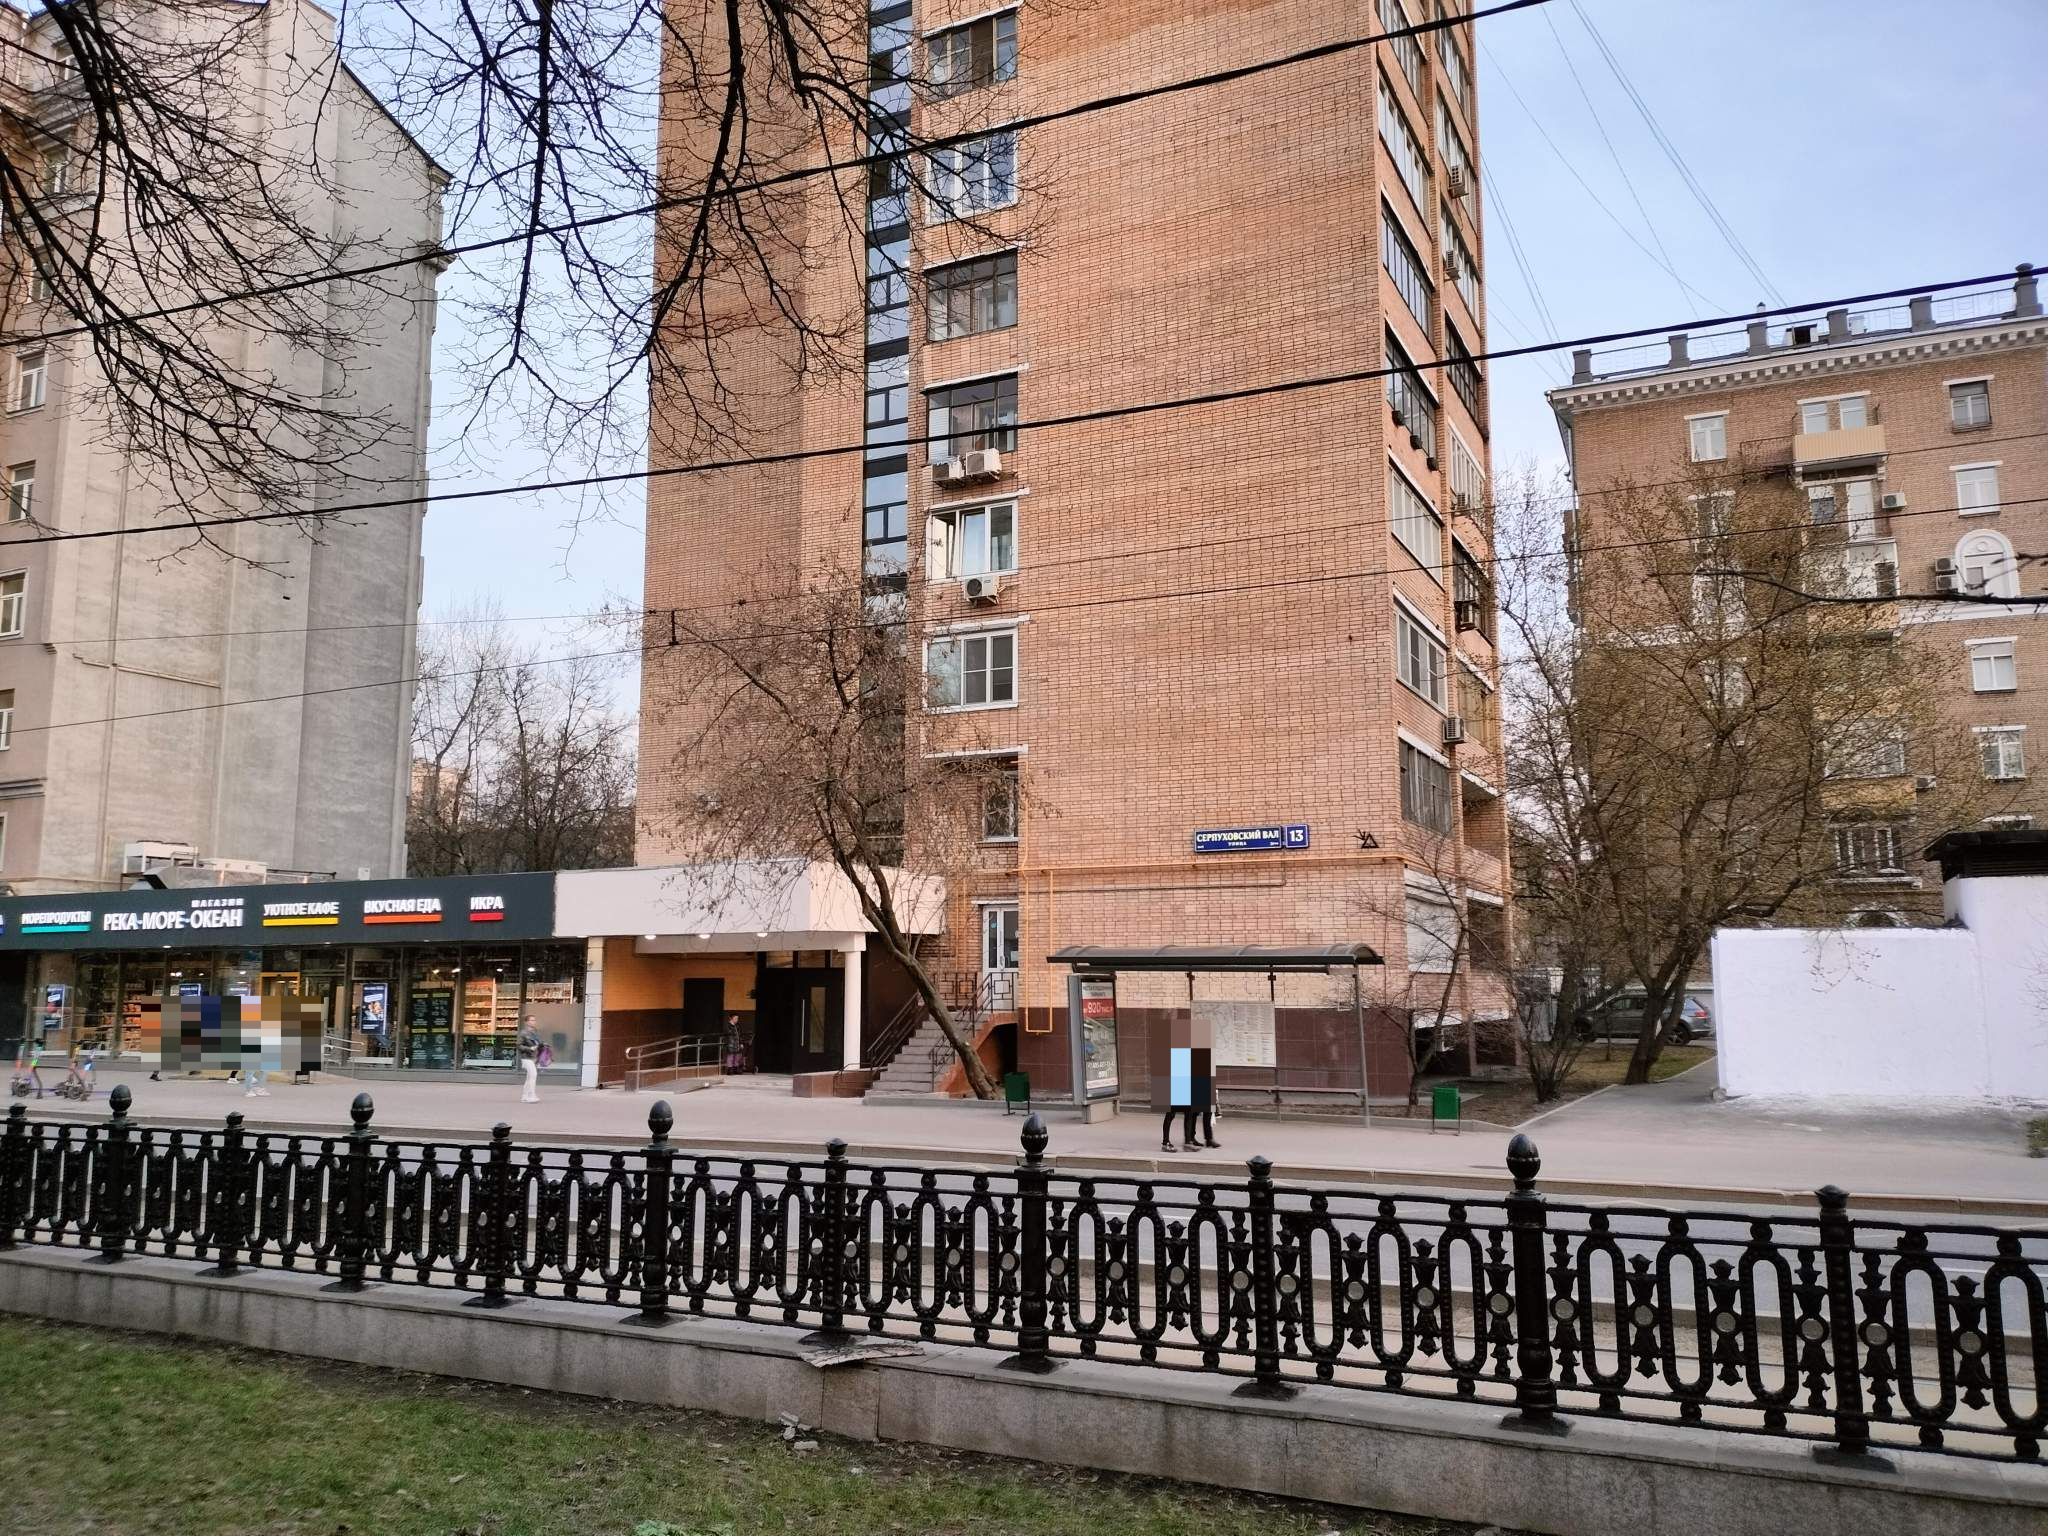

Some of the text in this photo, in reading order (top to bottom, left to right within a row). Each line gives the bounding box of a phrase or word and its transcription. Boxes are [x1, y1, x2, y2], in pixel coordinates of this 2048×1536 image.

[1197, 830, 1279, 842] СЕРПУХОВСКИЙ ВАЛ
[1290, 830, 1304, 842] 13
[191, 897, 244, 908] МАГАЗИН
[263, 901, 340, 916] УЮТНОЕ КАФЕ
[363, 898, 442, 914] ВКУСНАЯ ЕДА
[470, 896, 504, 910] ИКРА
[21, 911, 91, 925] МОРЕПРОДУКТЫ
[1088, 1002, 1101, 1013] 920
